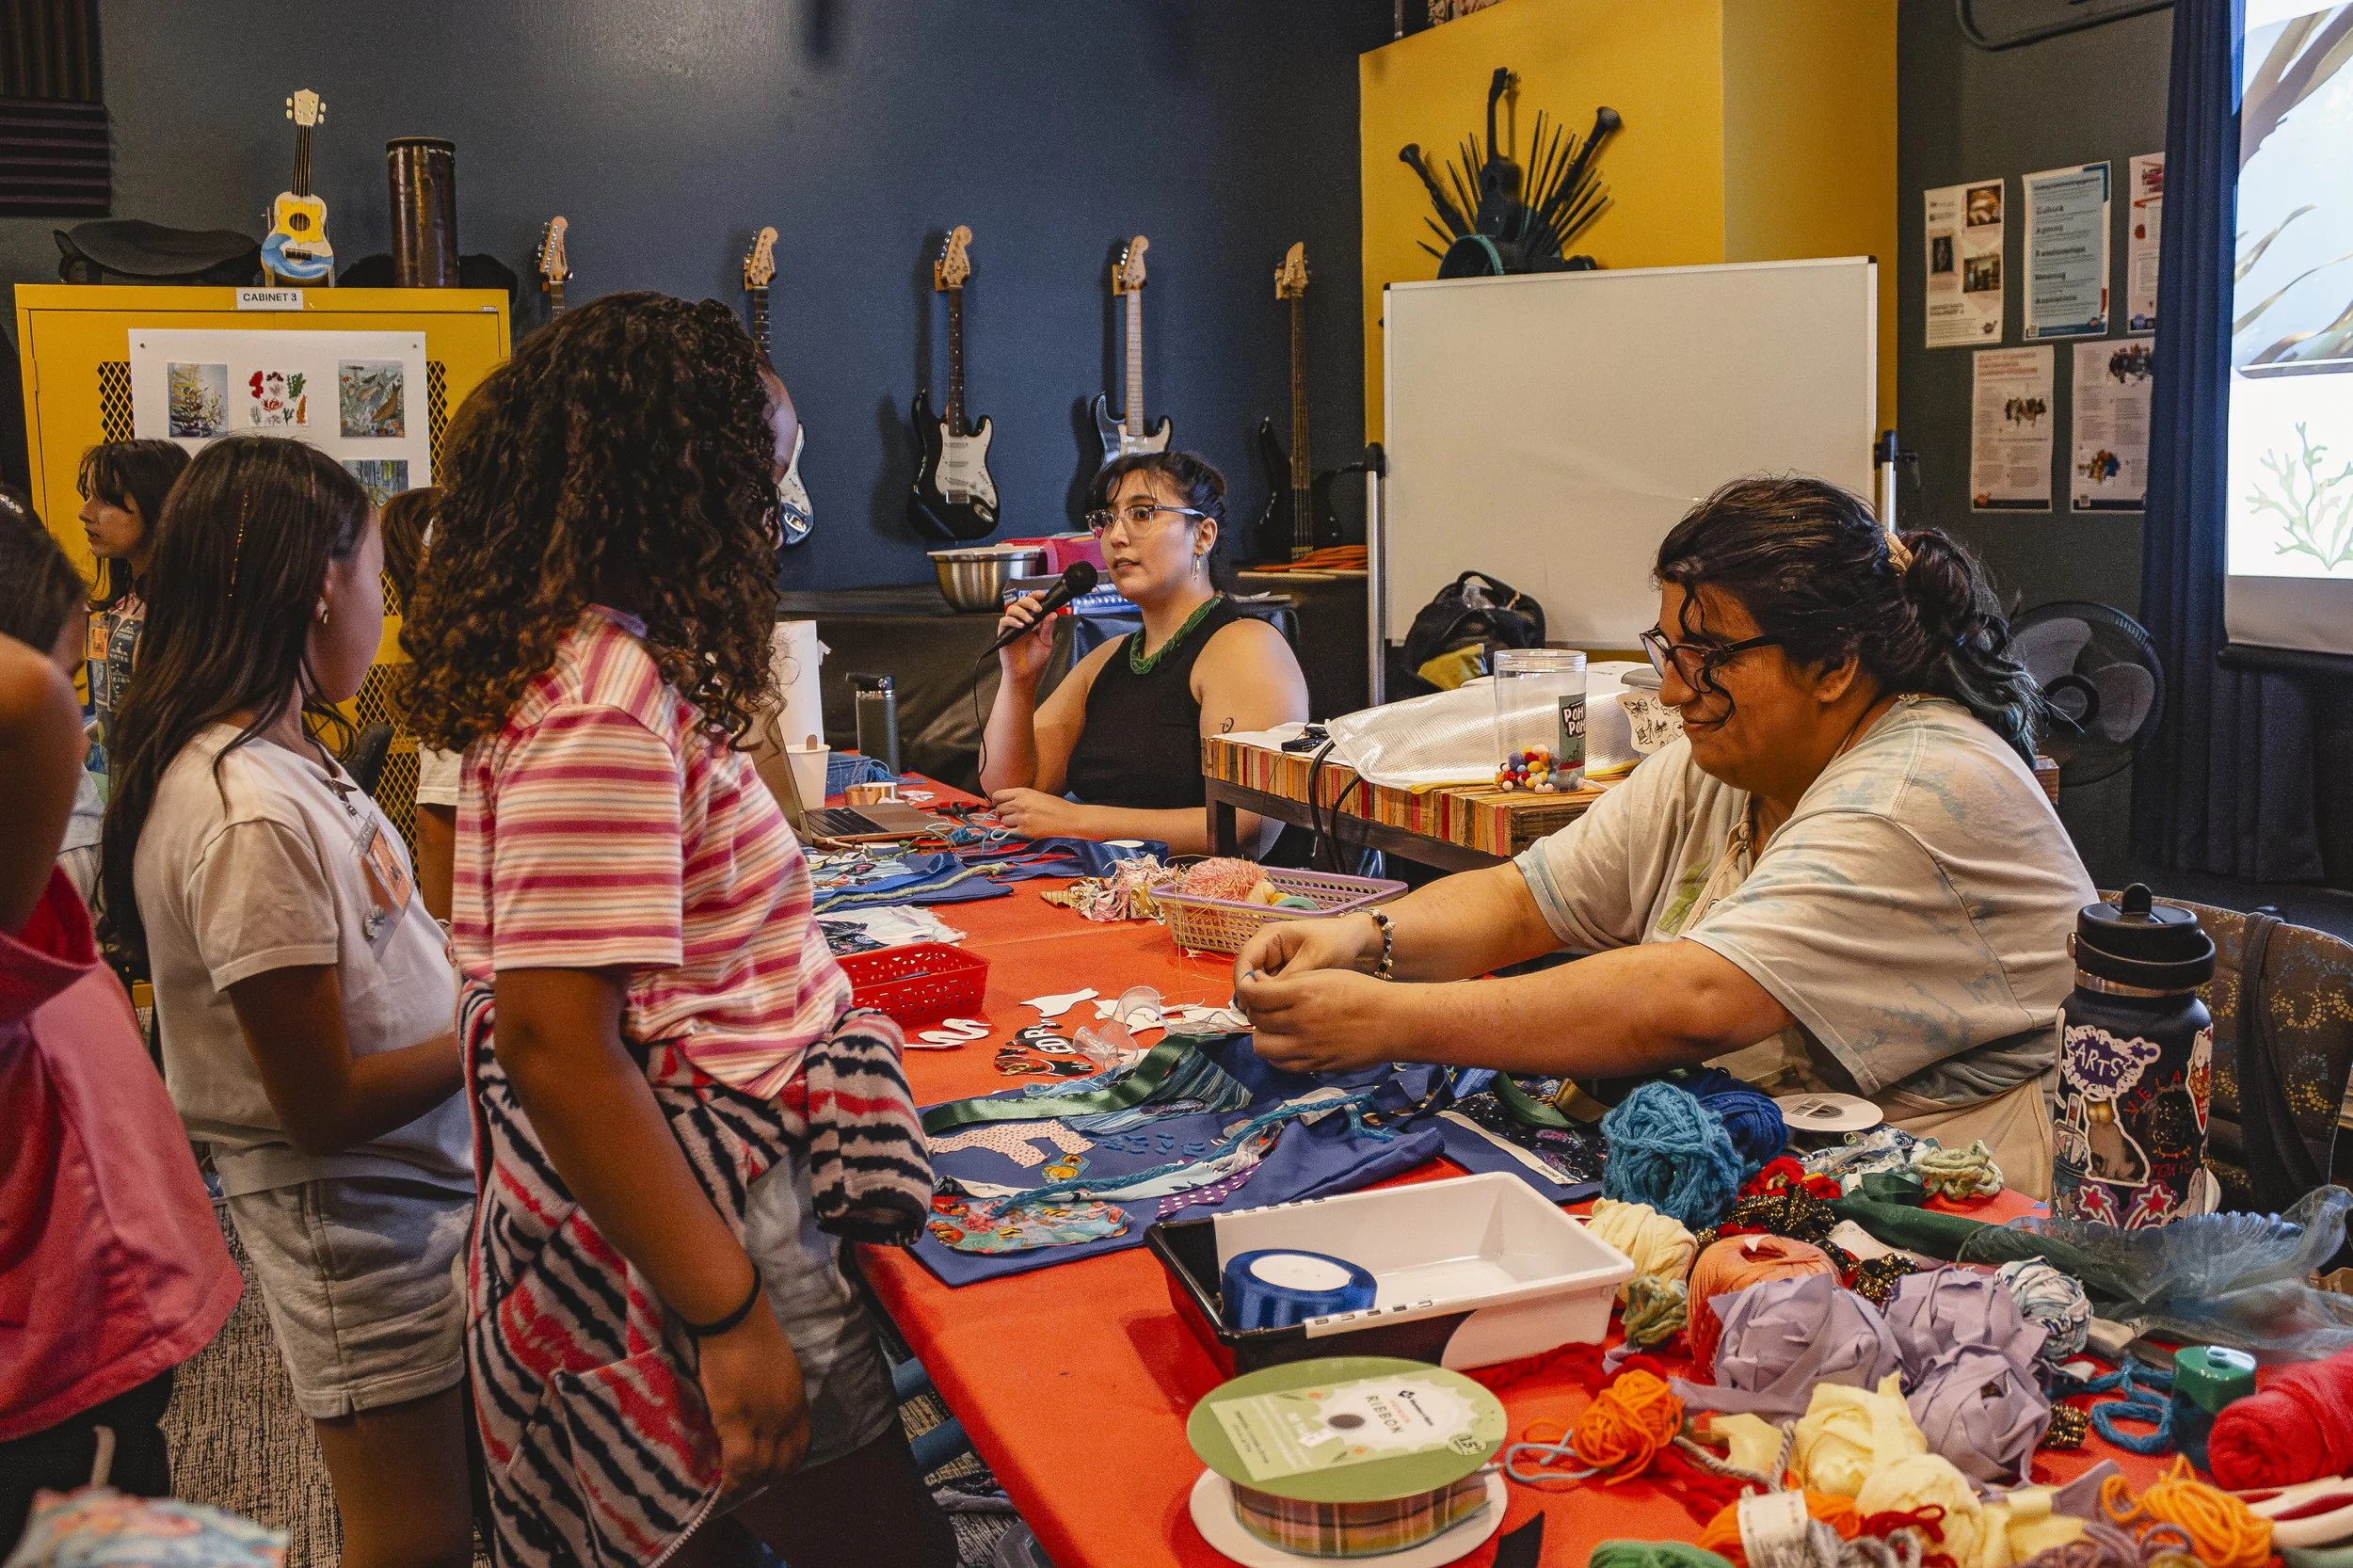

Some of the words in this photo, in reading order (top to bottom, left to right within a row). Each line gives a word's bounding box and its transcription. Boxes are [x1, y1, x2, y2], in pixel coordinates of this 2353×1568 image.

[243, 293, 288, 302] CABINET
[291, 293, 297, 301] 3
[2075, 1043, 2123, 1077] ARTS
[1366, 1395, 1404, 1434] RIBBON
